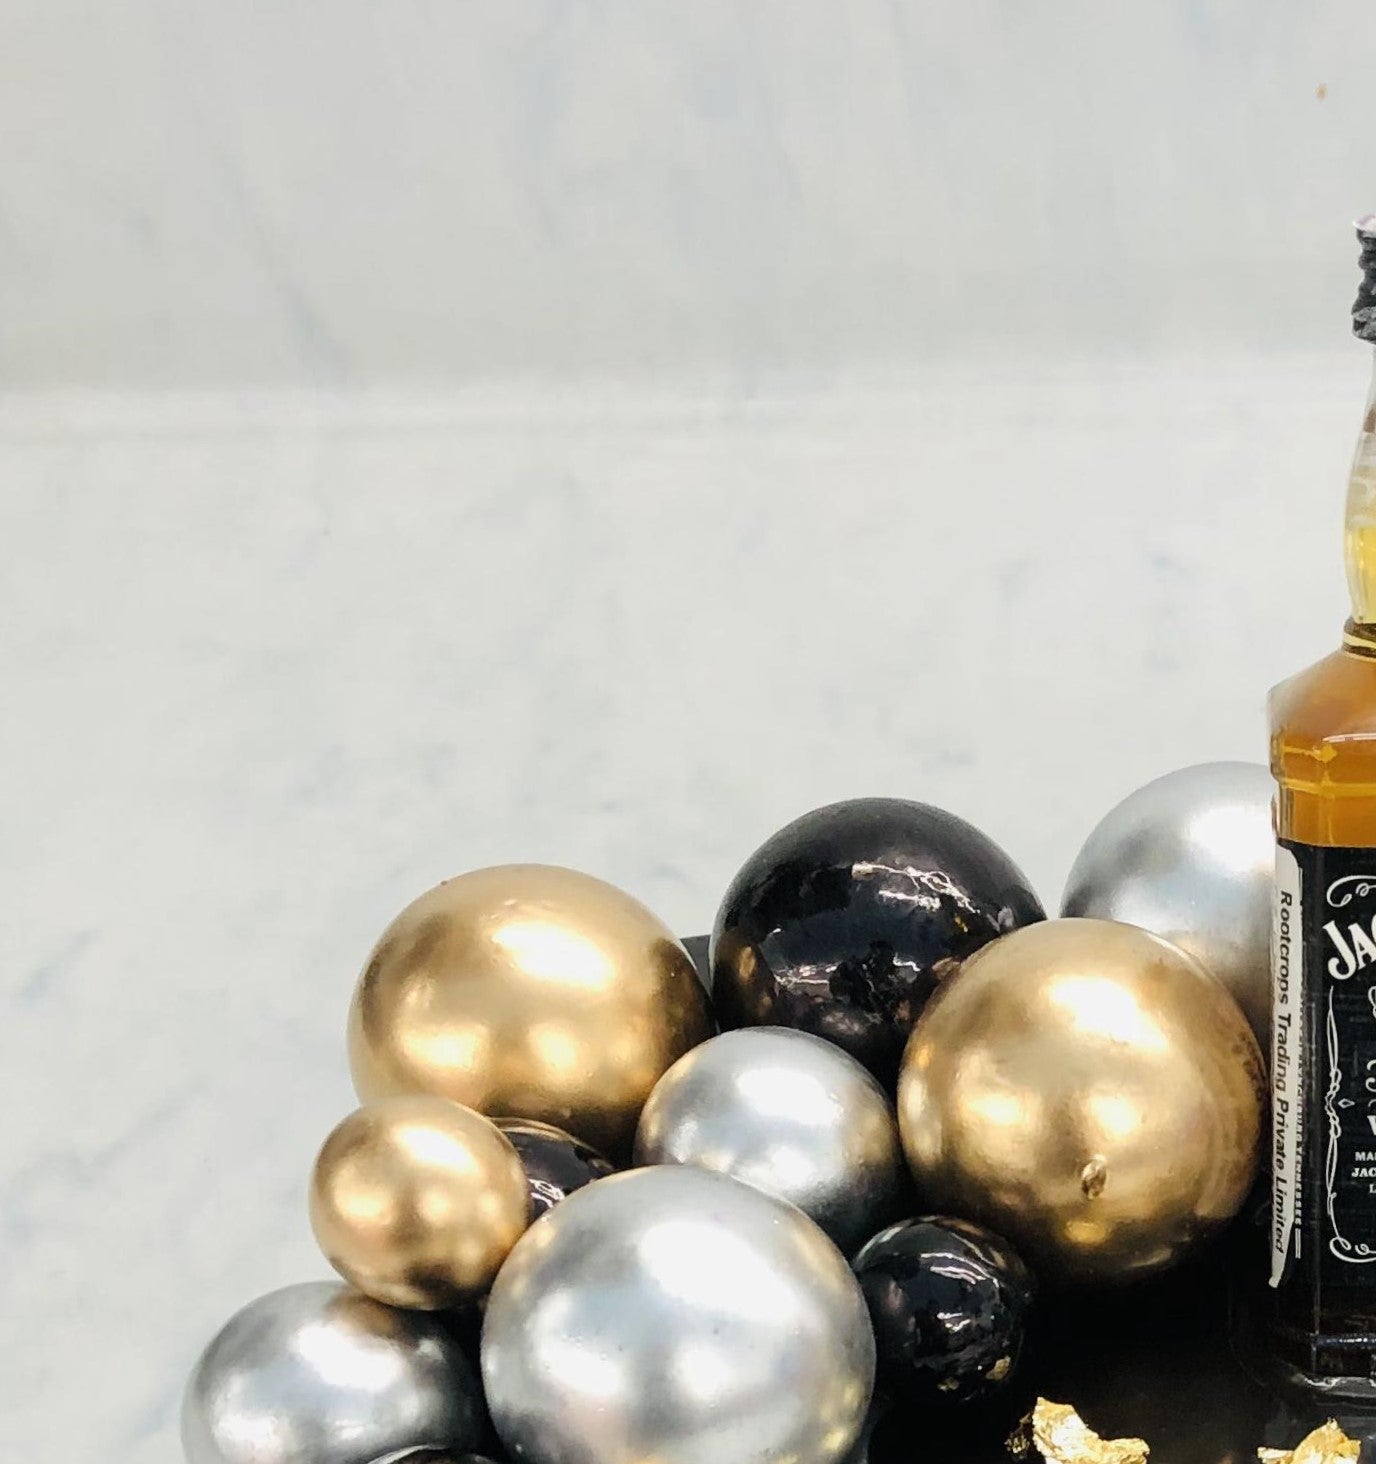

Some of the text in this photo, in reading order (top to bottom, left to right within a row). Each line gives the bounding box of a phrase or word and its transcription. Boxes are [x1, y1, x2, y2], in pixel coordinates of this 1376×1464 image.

[1275, 890, 1293, 1254] Rootcrops Trading Private Limited
